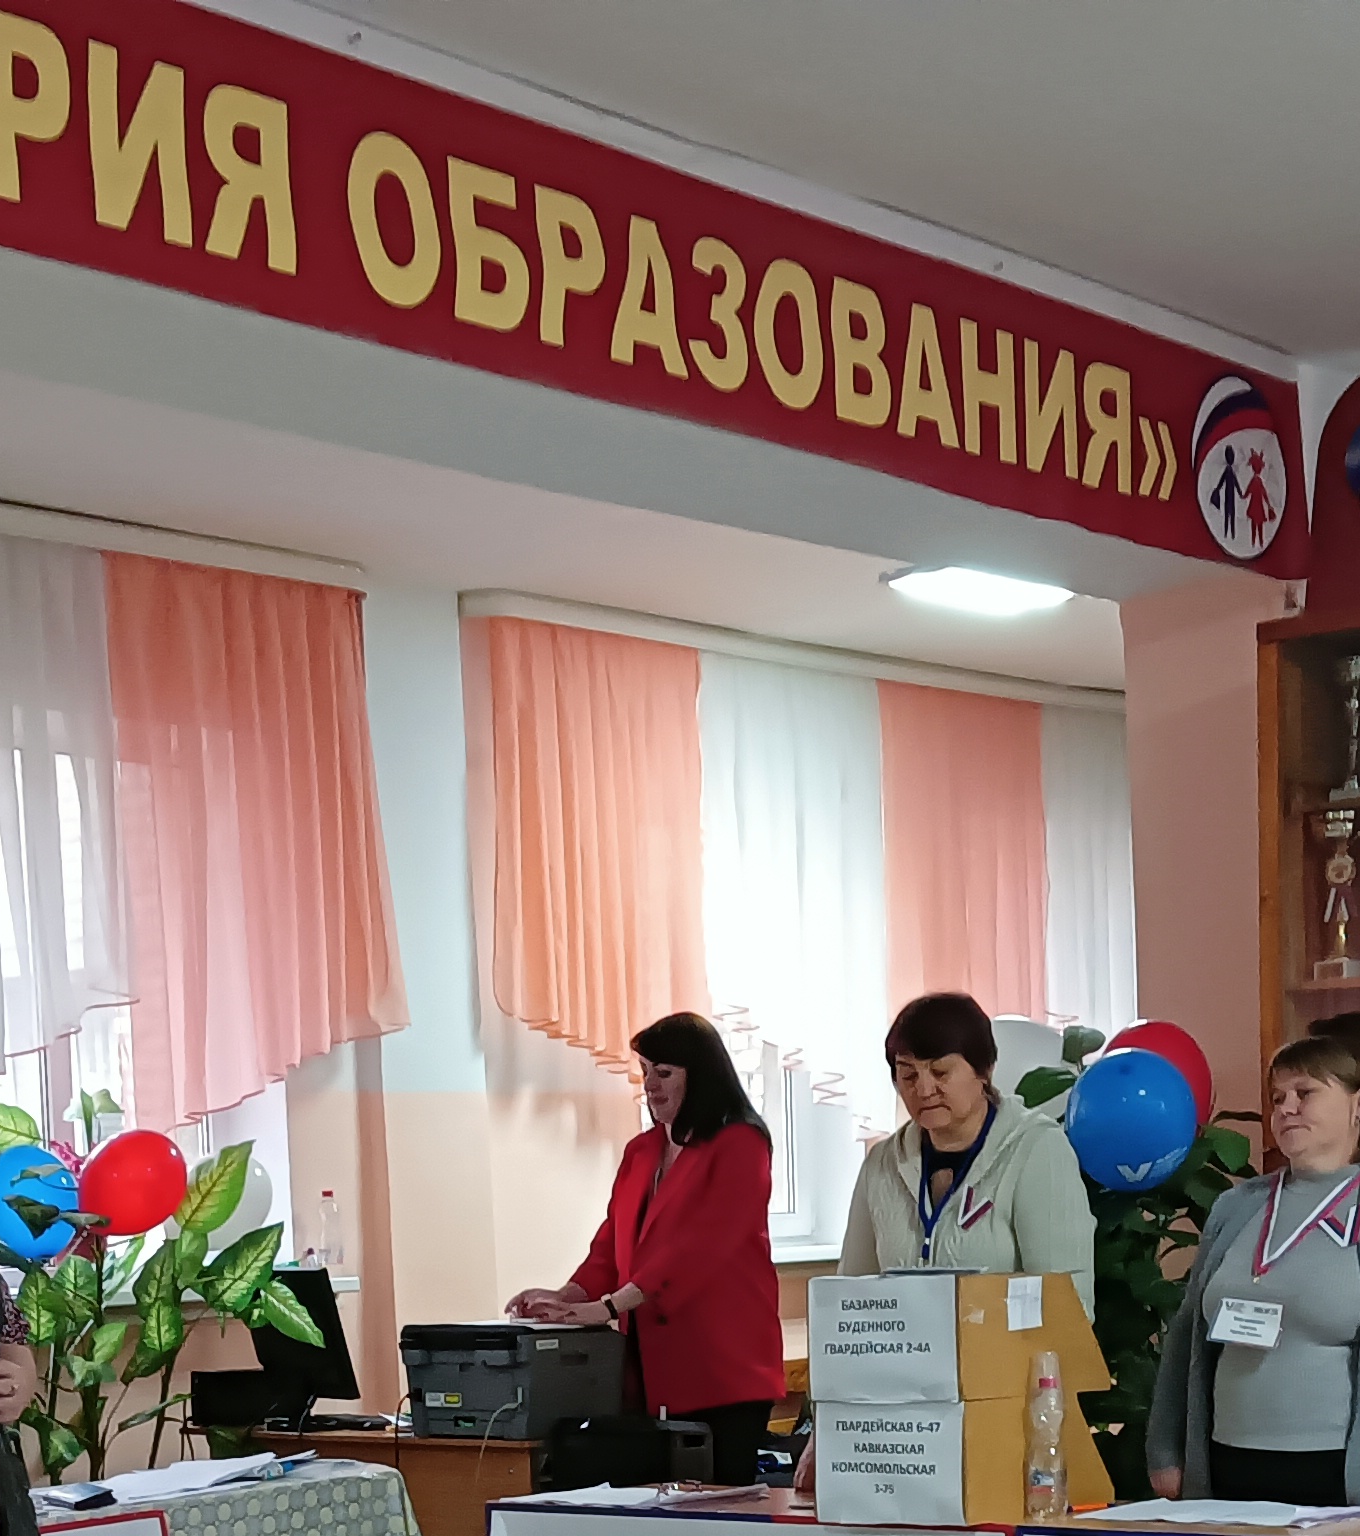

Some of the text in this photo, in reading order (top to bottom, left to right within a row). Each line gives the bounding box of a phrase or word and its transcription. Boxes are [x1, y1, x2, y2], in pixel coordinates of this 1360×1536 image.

[346, 131, 1177, 502] ОБРАЗОВАНИЯ»
[841, 1298, 898, 1311] БАЗАРНАЯ
[838, 1321, 905, 1334] БУДЕННОГО
[824, 1342, 931, 1356] ГВАРДЕЙСКАЯ 2-4А
[836, 1419, 913, 1434] ГВАРДЕЙСКАЯ
[853, 1443, 925, 1455] КАВКАЗСКАЯ
[831, 1462, 936, 1475] КОМСОМОЛЬСКАЯ
